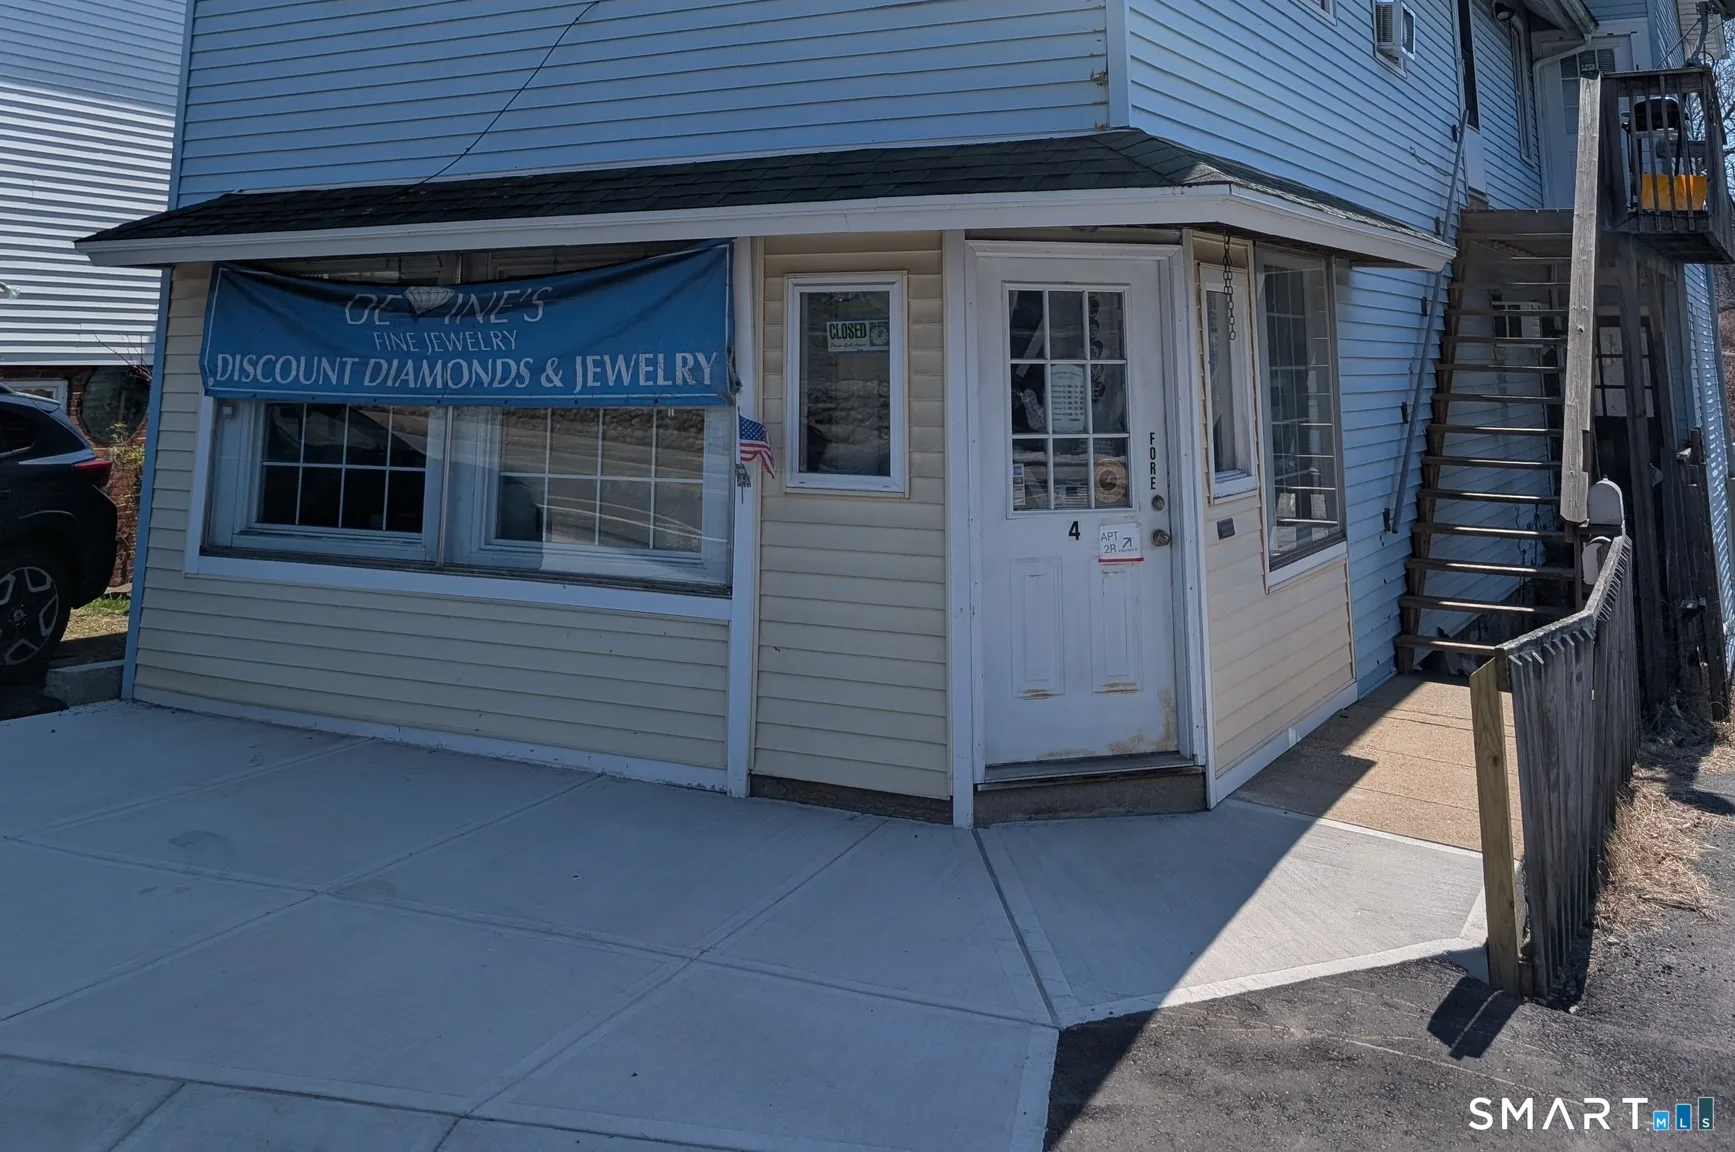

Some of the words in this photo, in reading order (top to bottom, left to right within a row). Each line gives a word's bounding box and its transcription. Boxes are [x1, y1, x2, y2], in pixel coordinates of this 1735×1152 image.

[345, 286, 553, 325] DEINE'S
[829, 323, 867, 340] CLOSED
[373, 332, 419, 352] FINE
[422, 330, 517, 355] JEWELRY
[216, 353, 359, 385] DISCOUNT
[364, 357, 533, 389] DIAMONDS
[540, 357, 565, 388] &
[573, 351, 717, 394] JEWELRY
[1068, 520, 1081, 541] 4
[1100, 531, 1119, 542] APT
[1103, 543, 1117, 554] 2R
